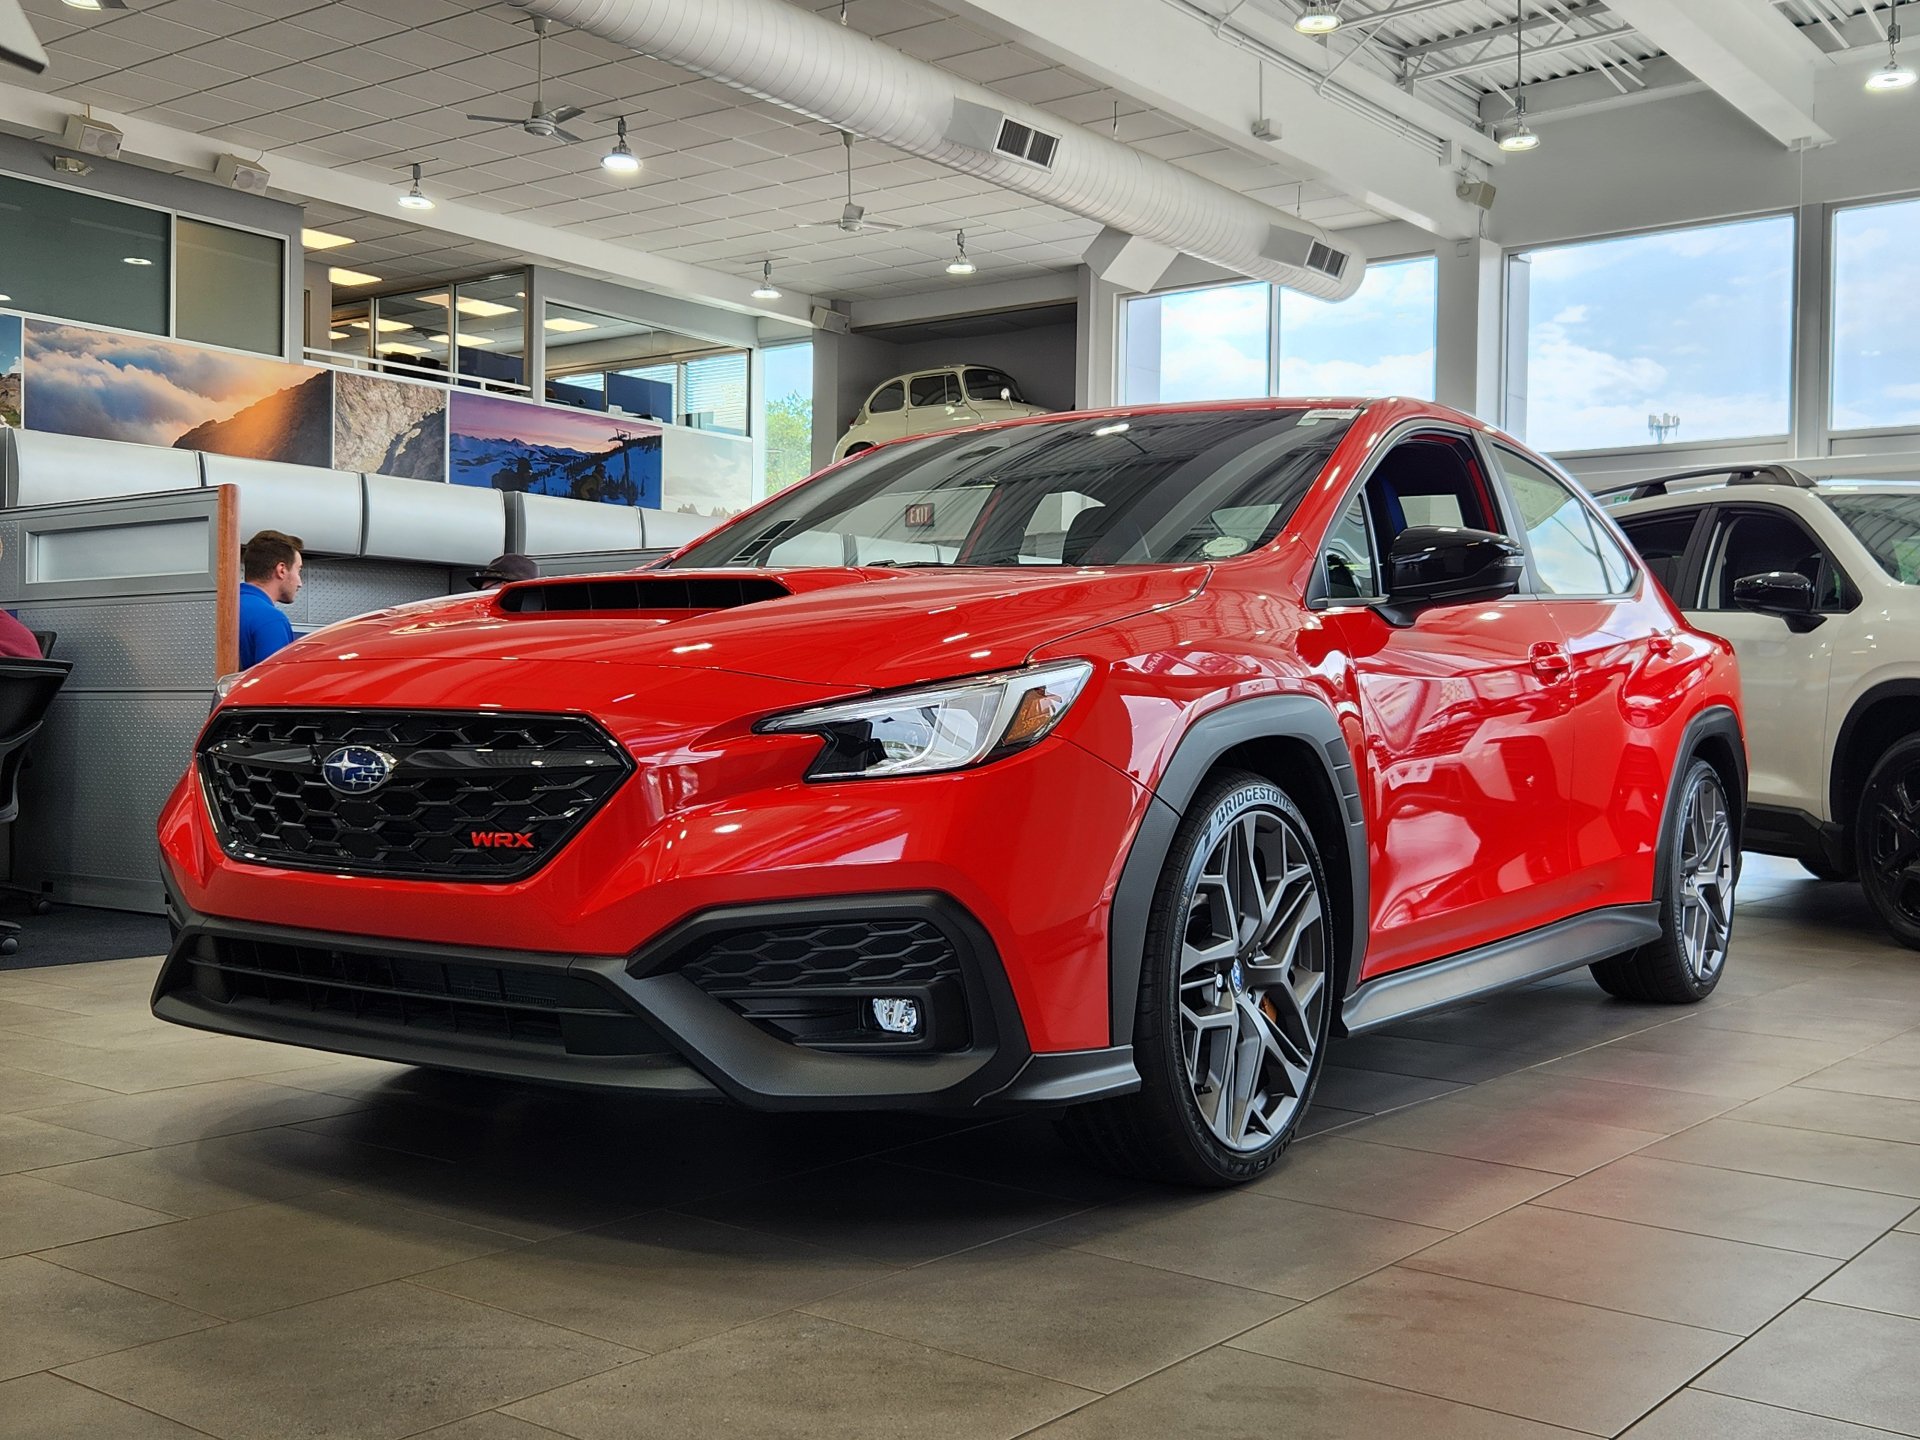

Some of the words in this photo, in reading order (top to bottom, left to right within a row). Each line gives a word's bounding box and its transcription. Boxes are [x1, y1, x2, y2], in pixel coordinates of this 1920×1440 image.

[910, 506, 929, 524] EXIT
[1215, 787, 1292, 827] BRIDGESTONE
[471, 831, 535, 849] WRX
